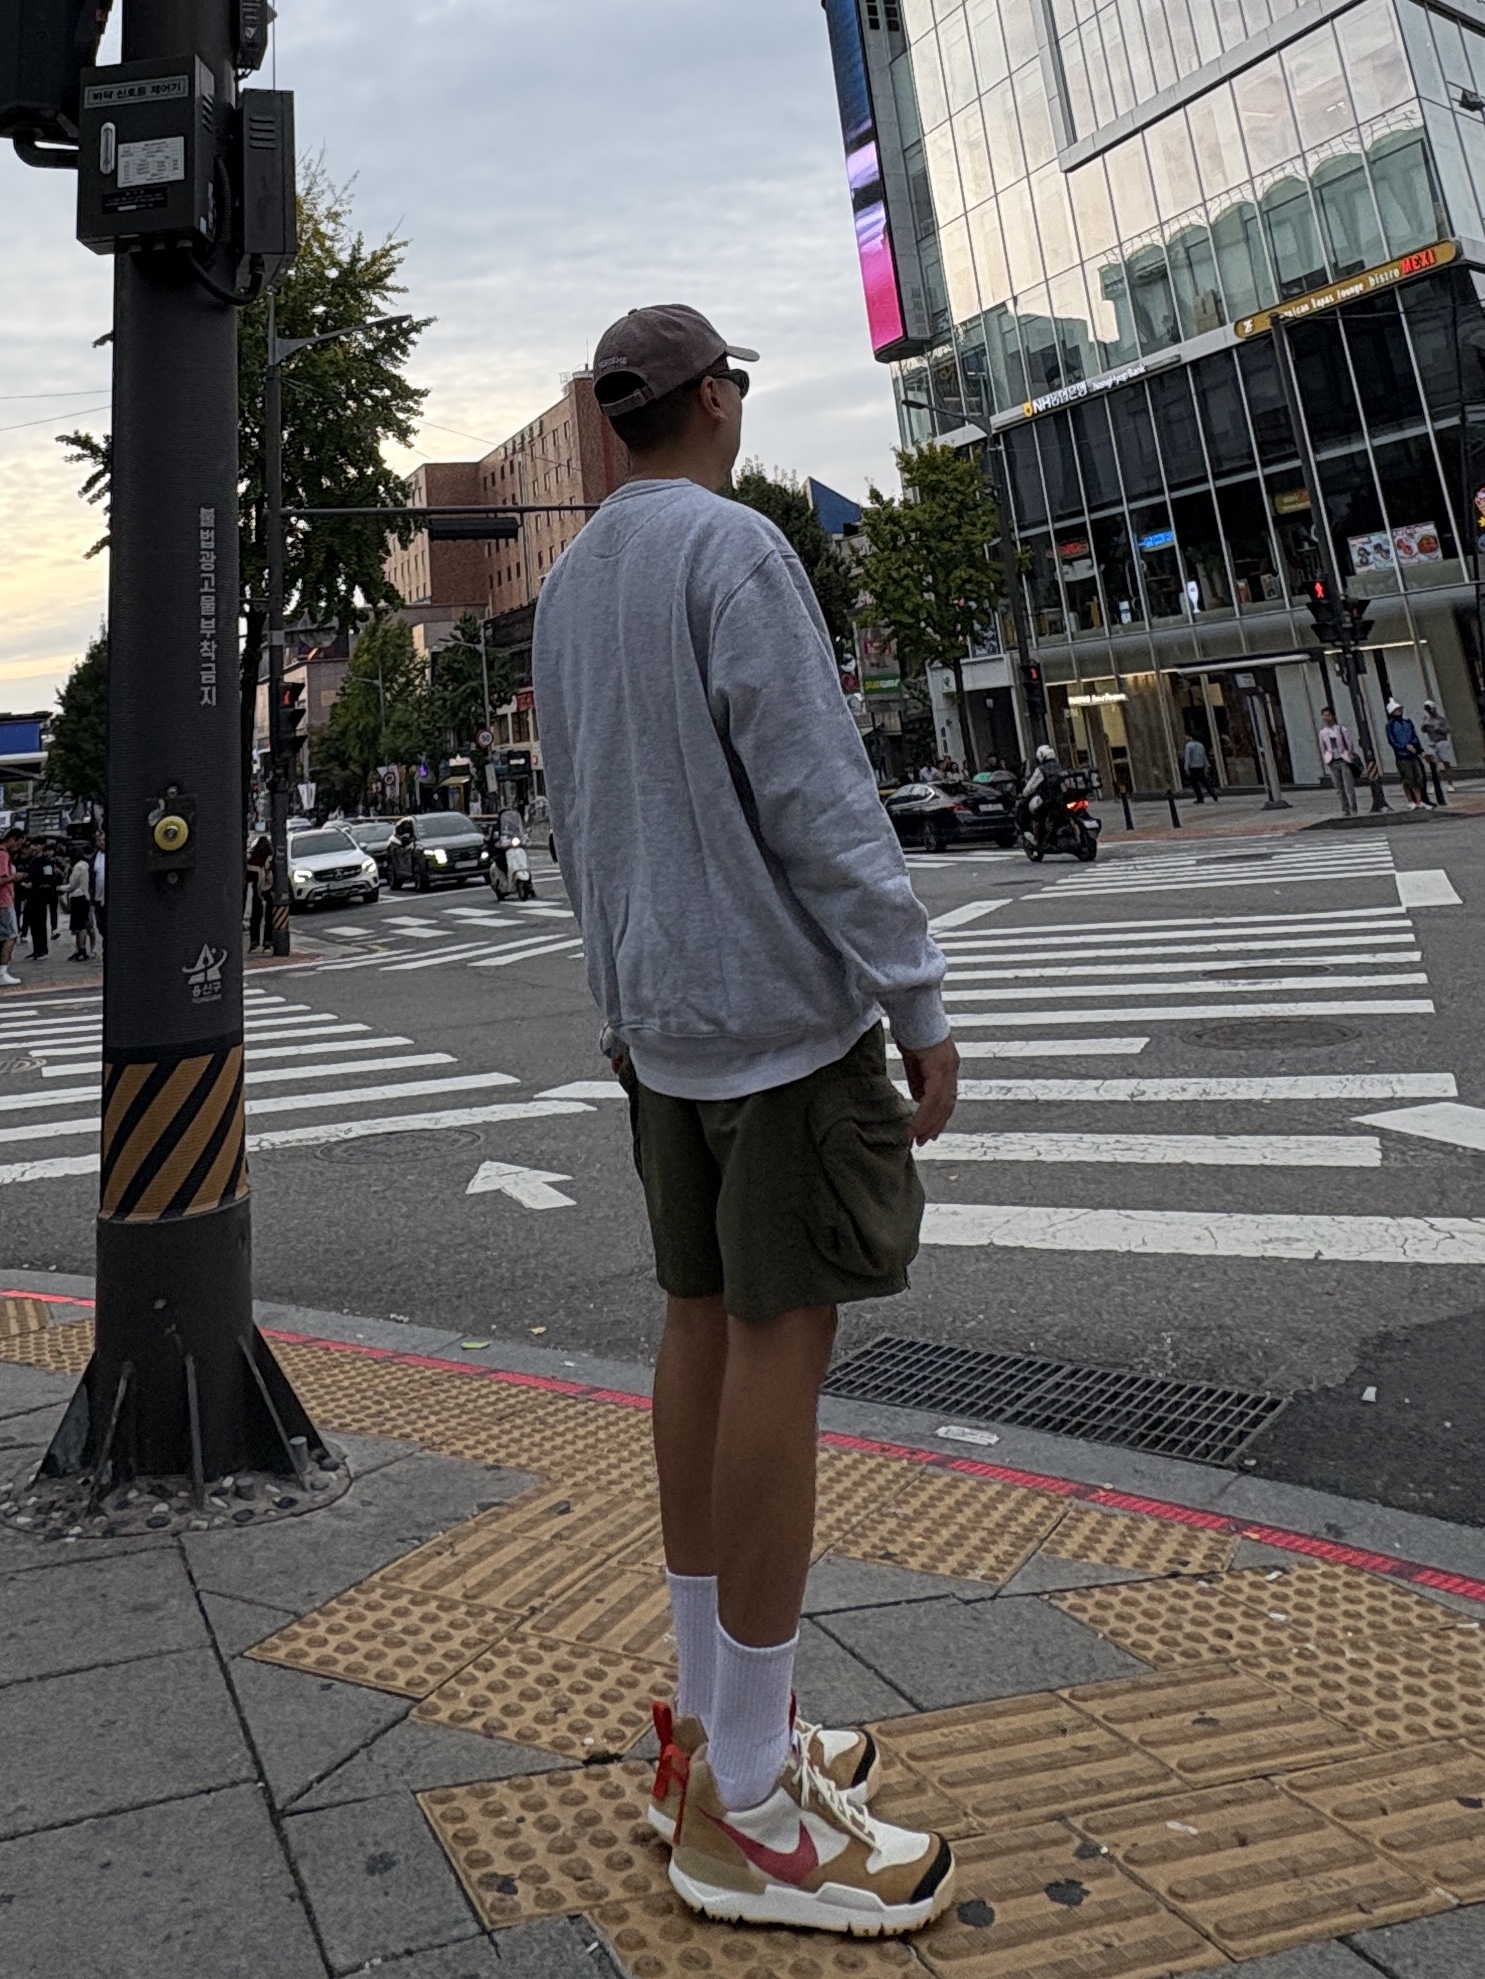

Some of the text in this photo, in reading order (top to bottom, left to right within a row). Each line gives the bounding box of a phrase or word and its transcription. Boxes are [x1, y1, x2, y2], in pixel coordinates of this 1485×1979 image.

[117, 86, 146, 99] 신호등
[150, 82, 181, 95] 제어기
[1368, 267, 1400, 287] bistro
[1401, 249, 1436, 275] MEXI
